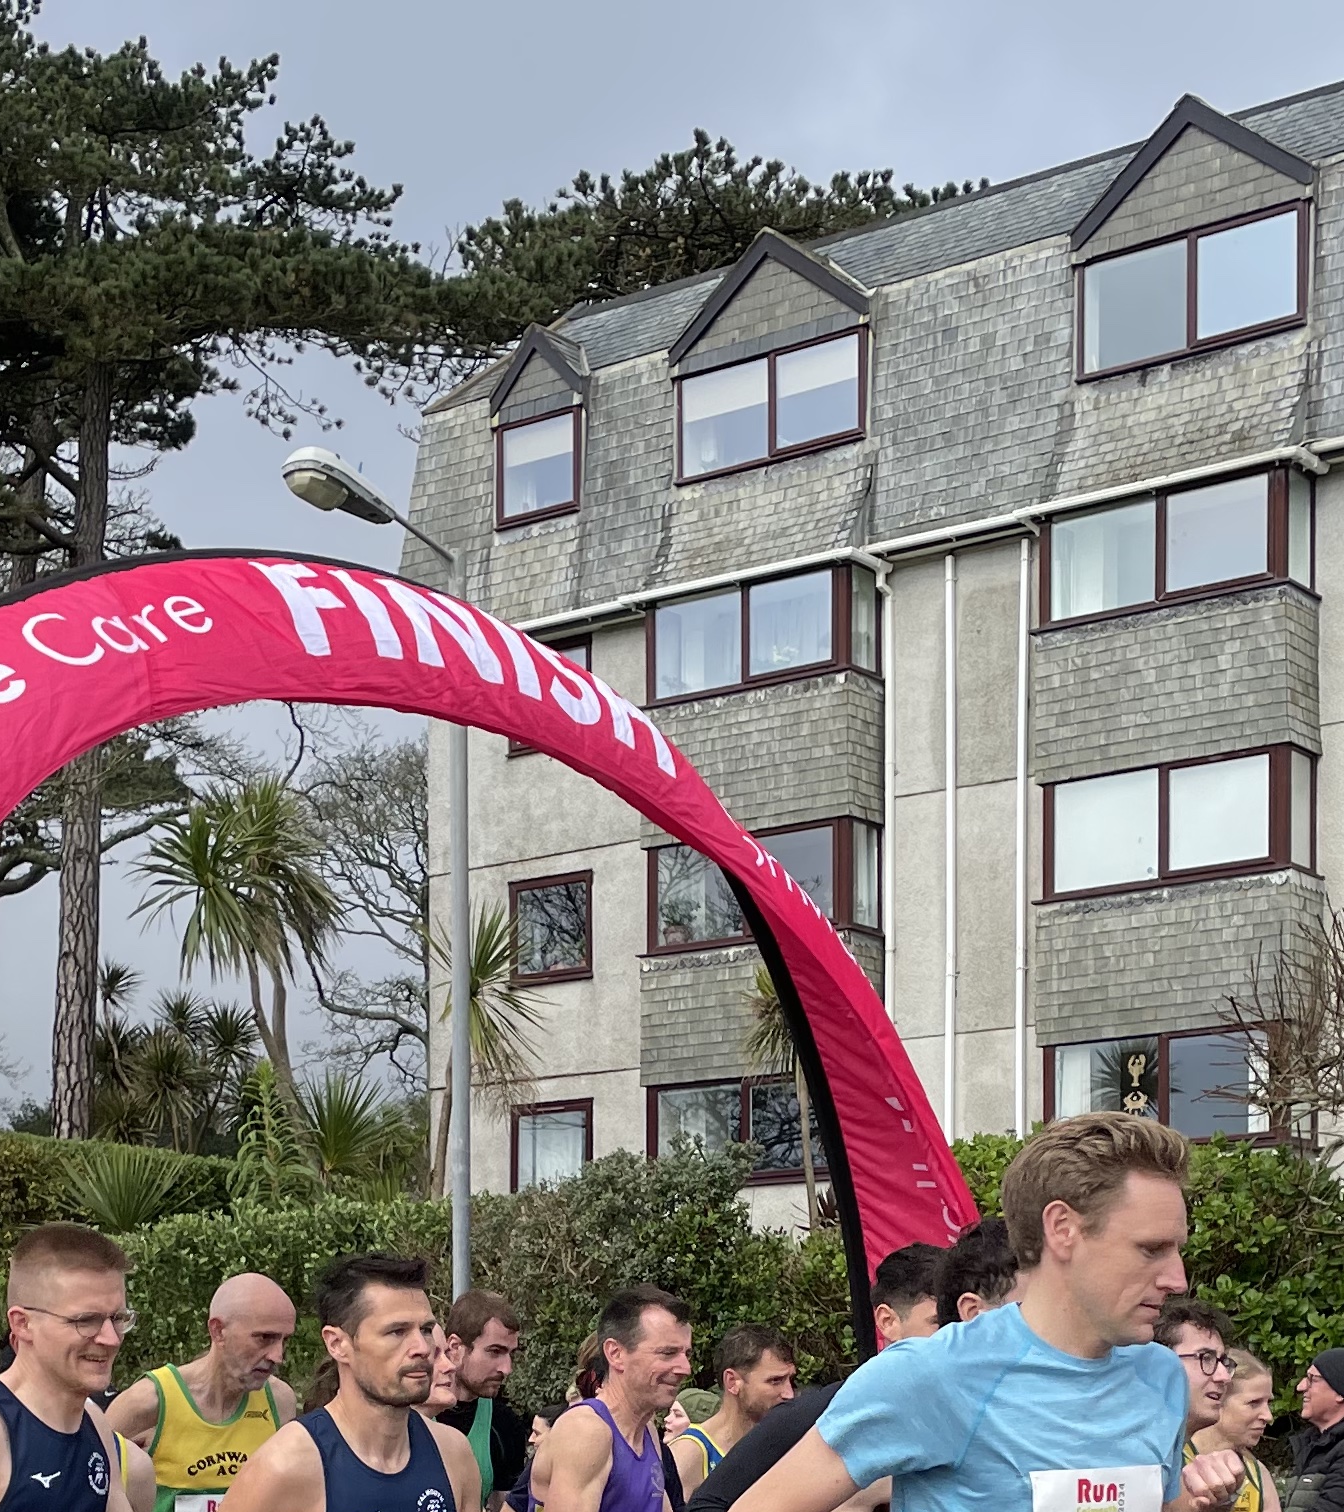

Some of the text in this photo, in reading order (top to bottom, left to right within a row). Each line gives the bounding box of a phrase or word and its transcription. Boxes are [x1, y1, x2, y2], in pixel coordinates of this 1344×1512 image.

[21, 593, 214, 668] Care
[248, 559, 677, 779] FINISH
[1077, 1478, 1118, 1504] Run
